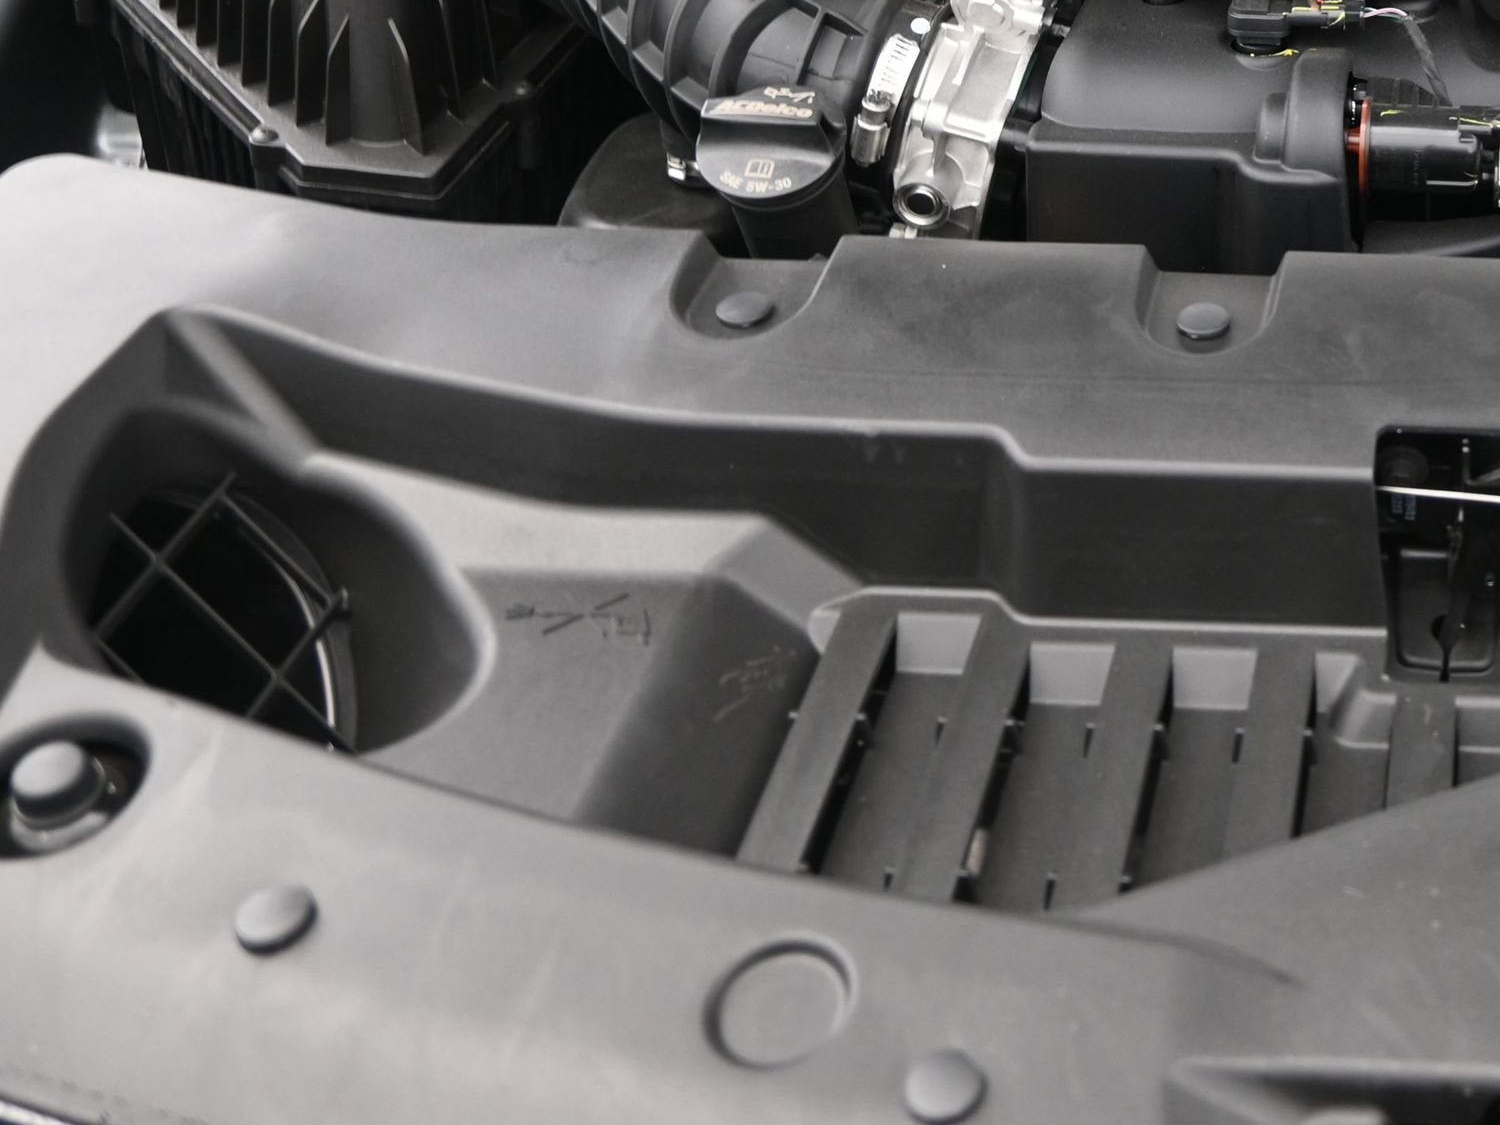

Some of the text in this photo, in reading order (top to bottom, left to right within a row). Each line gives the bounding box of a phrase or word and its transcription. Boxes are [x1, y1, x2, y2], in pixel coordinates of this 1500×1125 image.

[708, 99, 813, 118] ACDelco
[720, 171, 792, 193] SAE 5W-30
